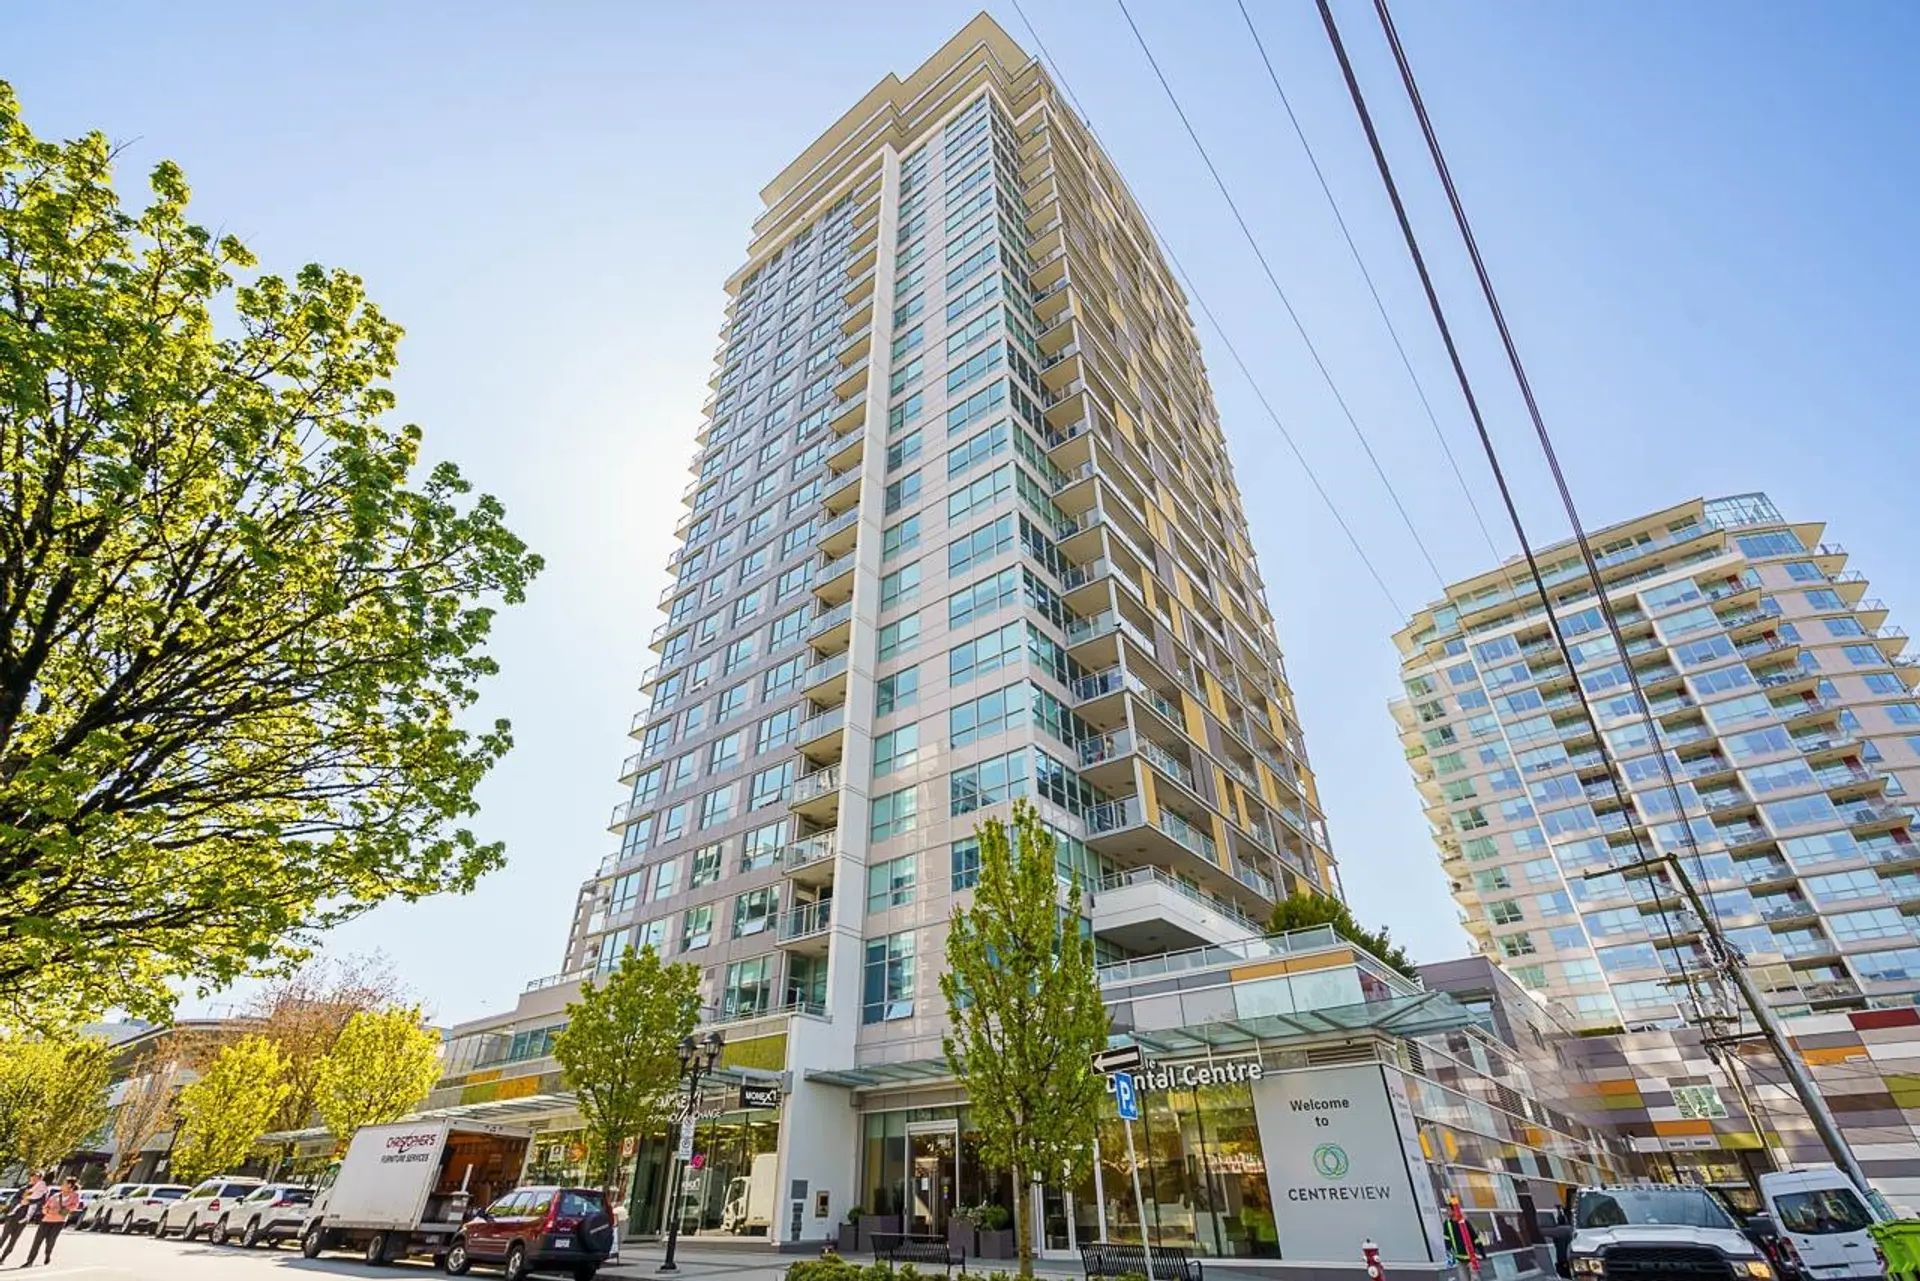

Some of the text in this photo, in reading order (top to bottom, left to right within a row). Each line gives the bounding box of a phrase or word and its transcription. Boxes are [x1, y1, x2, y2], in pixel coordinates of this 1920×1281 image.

[1106, 1067, 1176, 1093] Dntal
[1183, 1062, 1263, 1086] Centre
[1119, 1081, 1132, 1109] P
[1290, 1099, 1349, 1112] Welcome
[1315, 1116, 1329, 1127] to
[1288, 1186, 1391, 1201] CENTREVIEW
